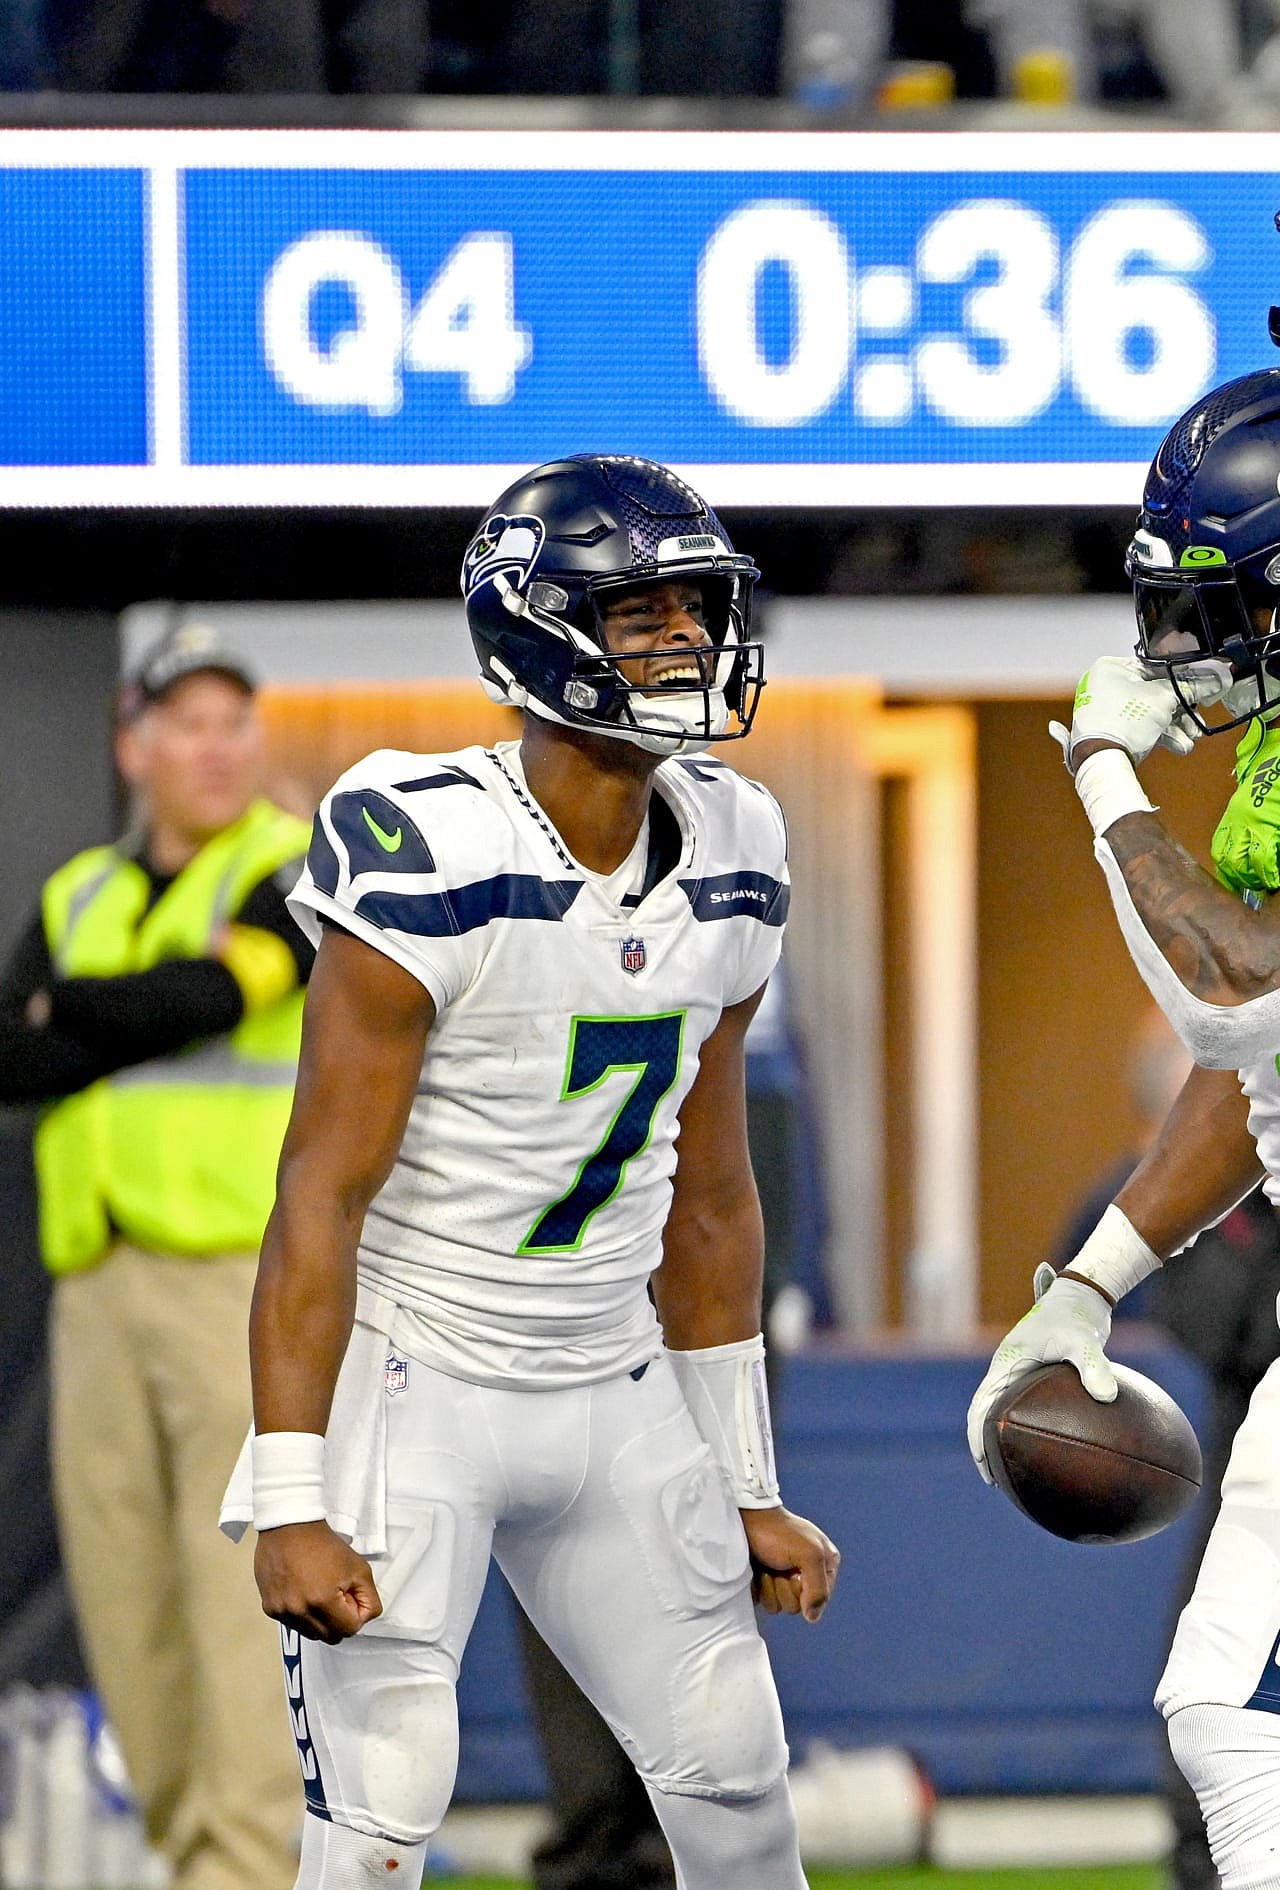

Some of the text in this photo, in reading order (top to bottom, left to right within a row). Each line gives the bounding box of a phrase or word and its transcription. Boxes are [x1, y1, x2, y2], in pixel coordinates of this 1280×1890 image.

[261, 230, 533, 417] Q4
[696, 198, 1218, 427] 0:36
[678, 536, 716, 549] SEAHAWKS
[516, 1009, 688, 1255] 7
